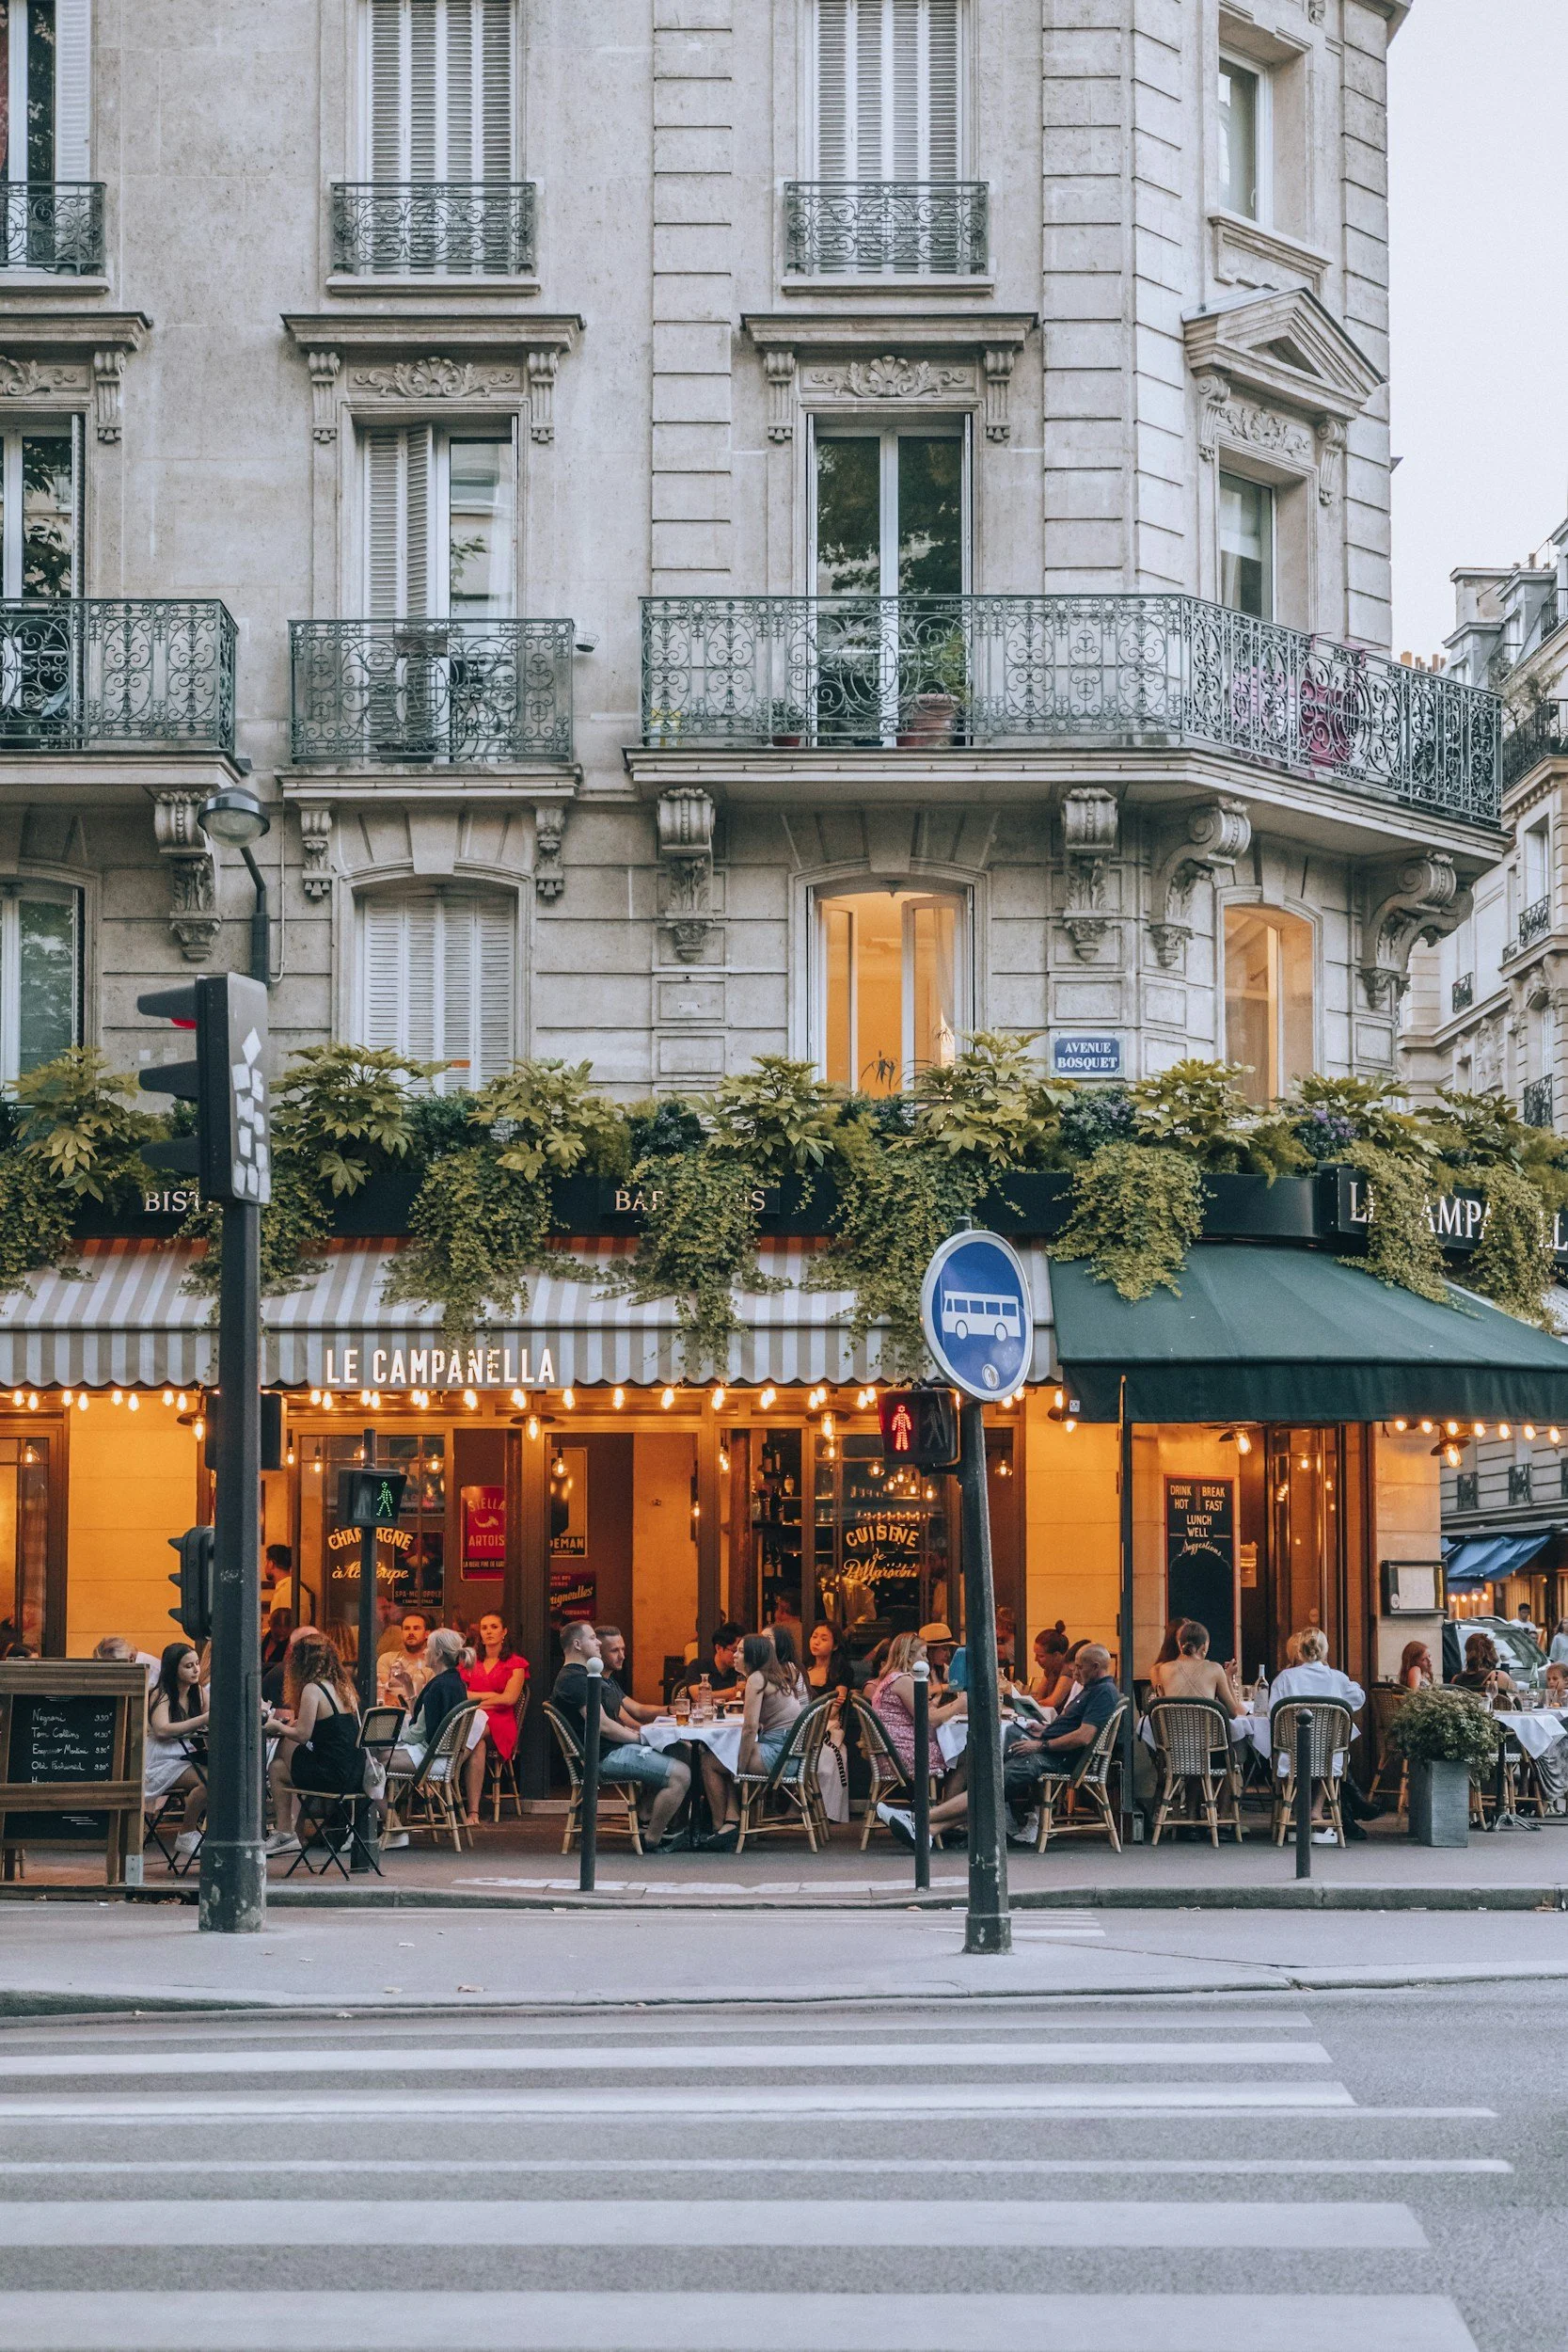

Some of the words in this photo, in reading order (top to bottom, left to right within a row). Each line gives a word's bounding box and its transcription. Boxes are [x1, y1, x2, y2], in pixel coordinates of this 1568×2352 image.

[1064, 1041, 1112, 1054] AVENUE
[1057, 1057, 1117, 1071] BOSQUET
[326, 1349, 358, 1384] LE
[372, 1348, 556, 1384] CAMPANELLA
[1170, 1485, 1193, 1497] DRINK
[1201, 1486, 1226, 1498] BREAK
[467, 1497, 507, 1513] STELLA
[1174, 1498, 1189, 1510] HOT
[1205, 1500, 1224, 1512] FAST
[1186, 1514, 1212, 1526] LUNCH
[846, 1524, 920, 1549] CUISINE
[1187, 1527, 1209, 1538] WELL
[468, 1534, 506, 1548] ARTOIS
[1180, 1538, 1223, 1557] Suggestions
[872, 1547, 887, 1561] de
[376, 1561, 409, 1585] oupe
[395, 1590, 442, 1598] SPA-MOOPOLE
[32, 1708, 66, 1726] Negroni
[31, 1726, 49, 1739] Tom
[52, 1726, 80, 1740] Collins
